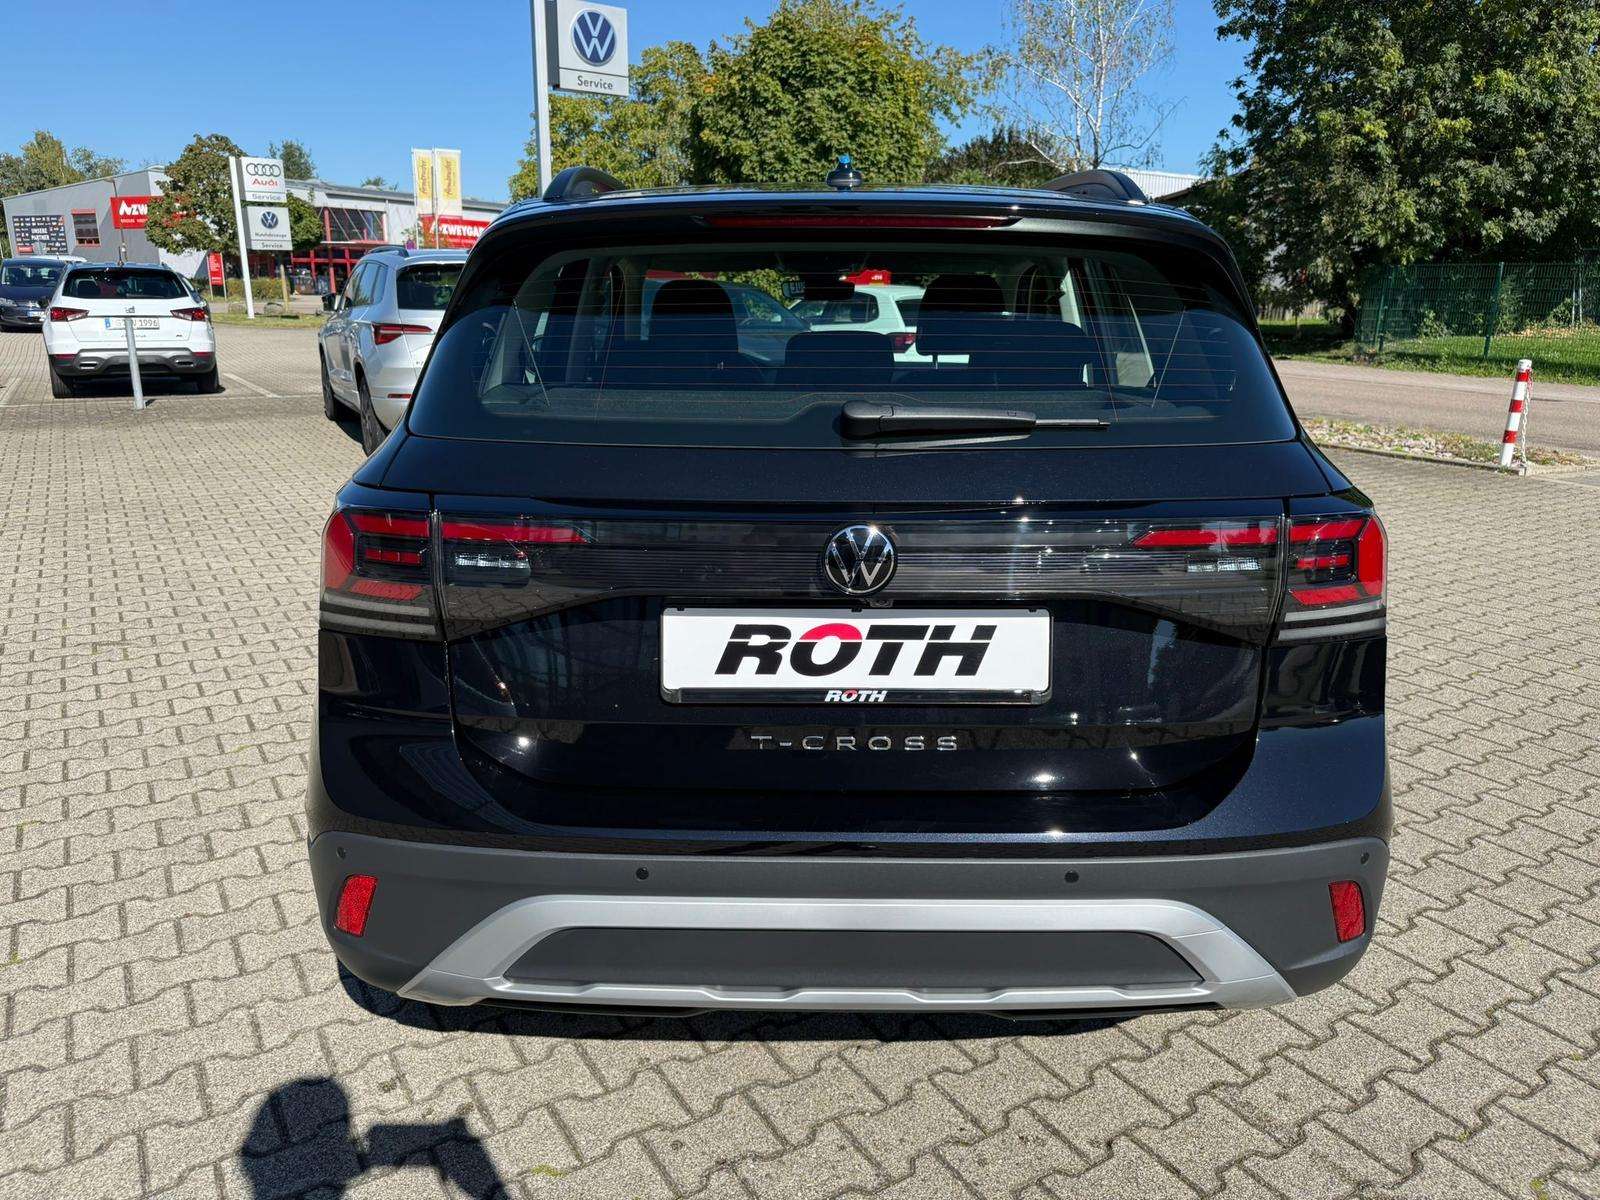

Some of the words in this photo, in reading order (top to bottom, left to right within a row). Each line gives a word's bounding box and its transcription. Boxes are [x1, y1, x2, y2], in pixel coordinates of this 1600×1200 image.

[577, 75, 613, 90] Service
[252, 178, 278, 187] Audi
[251, 193, 282, 201] Service
[261, 242, 283, 250] Service
[714, 623, 997, 676] ROTH
[824, 689, 888, 702] ROTH
[751, 735, 957, 750] T-CROSS
